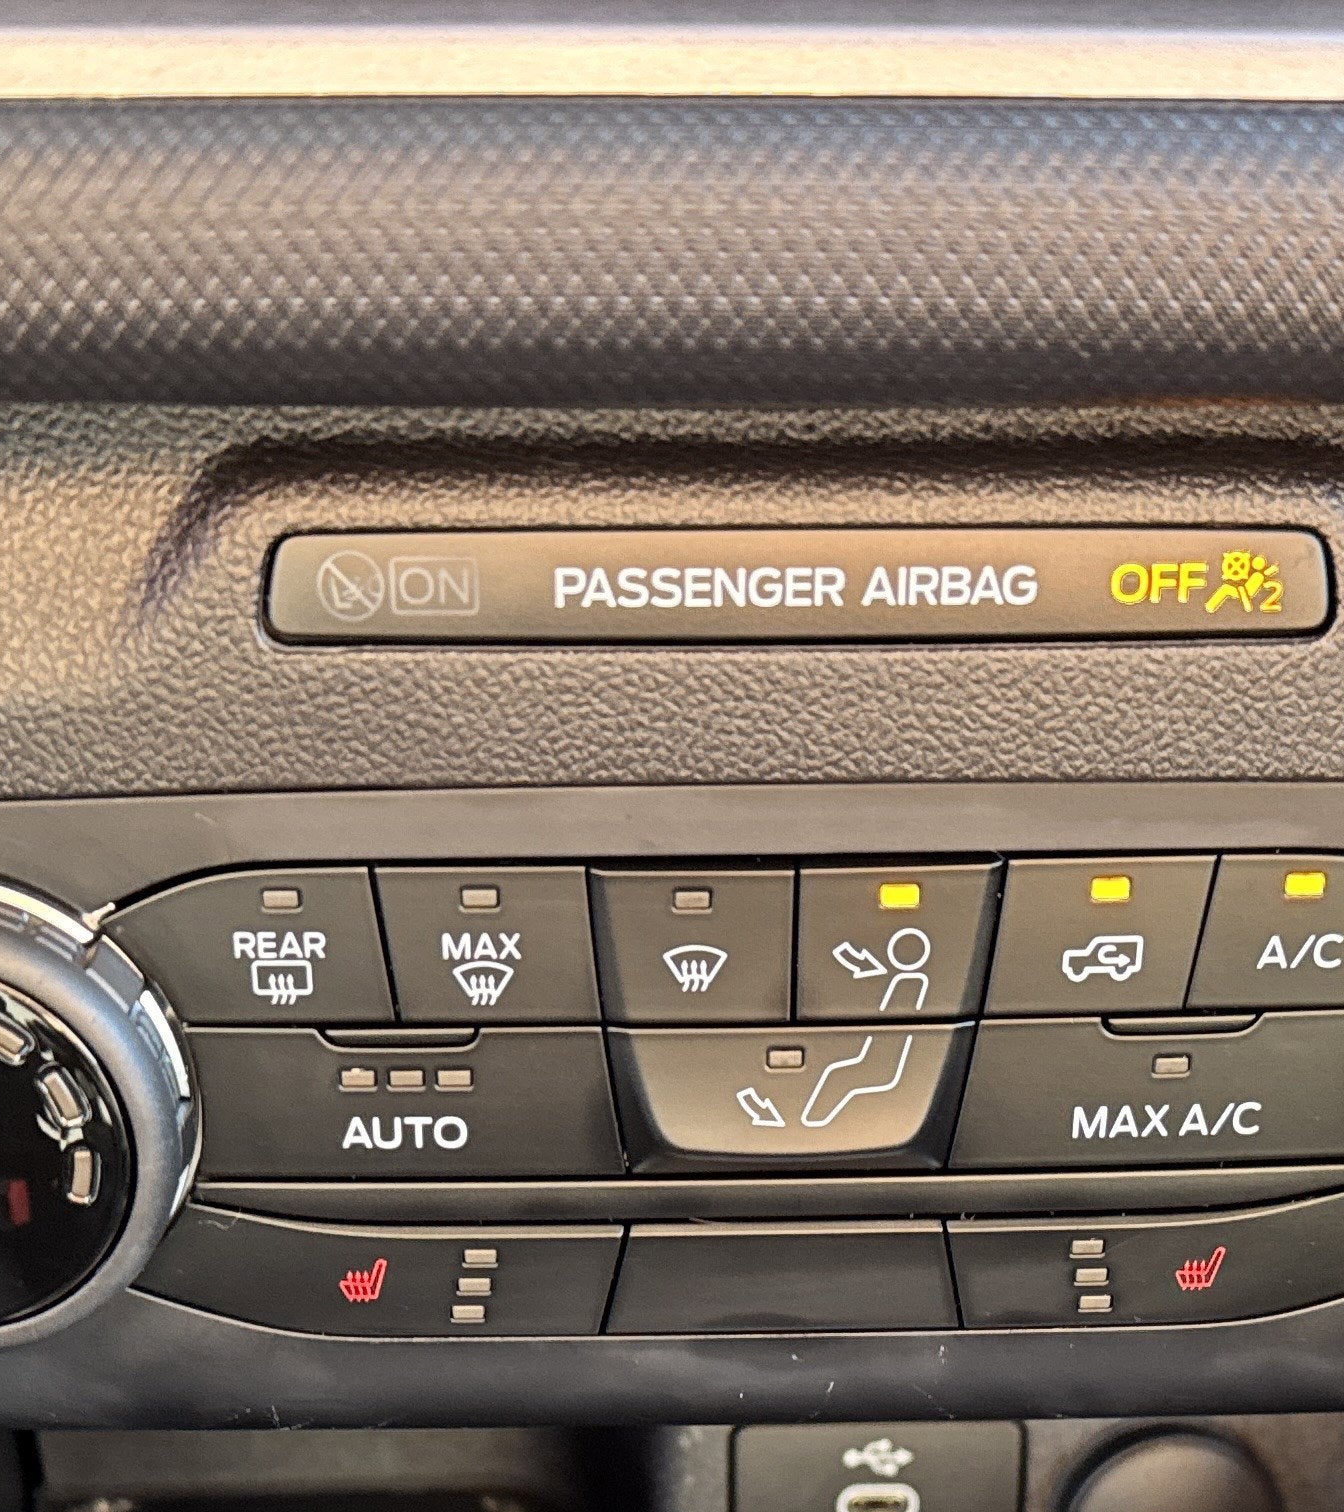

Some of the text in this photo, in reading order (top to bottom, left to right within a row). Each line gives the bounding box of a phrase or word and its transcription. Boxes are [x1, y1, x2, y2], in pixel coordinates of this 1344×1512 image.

[399, 565, 471, 606] ON
[553, 564, 1038, 609] PASSENGER AIRBAG
[1110, 561, 1209, 606] OFF
[232, 931, 327, 959] REAR
[441, 932, 522, 960] MAX
[1256, 933, 1344, 970] A/C
[342, 1115, 469, 1150] AUTO
[1071, 1101, 1262, 1139] MAX A/C
